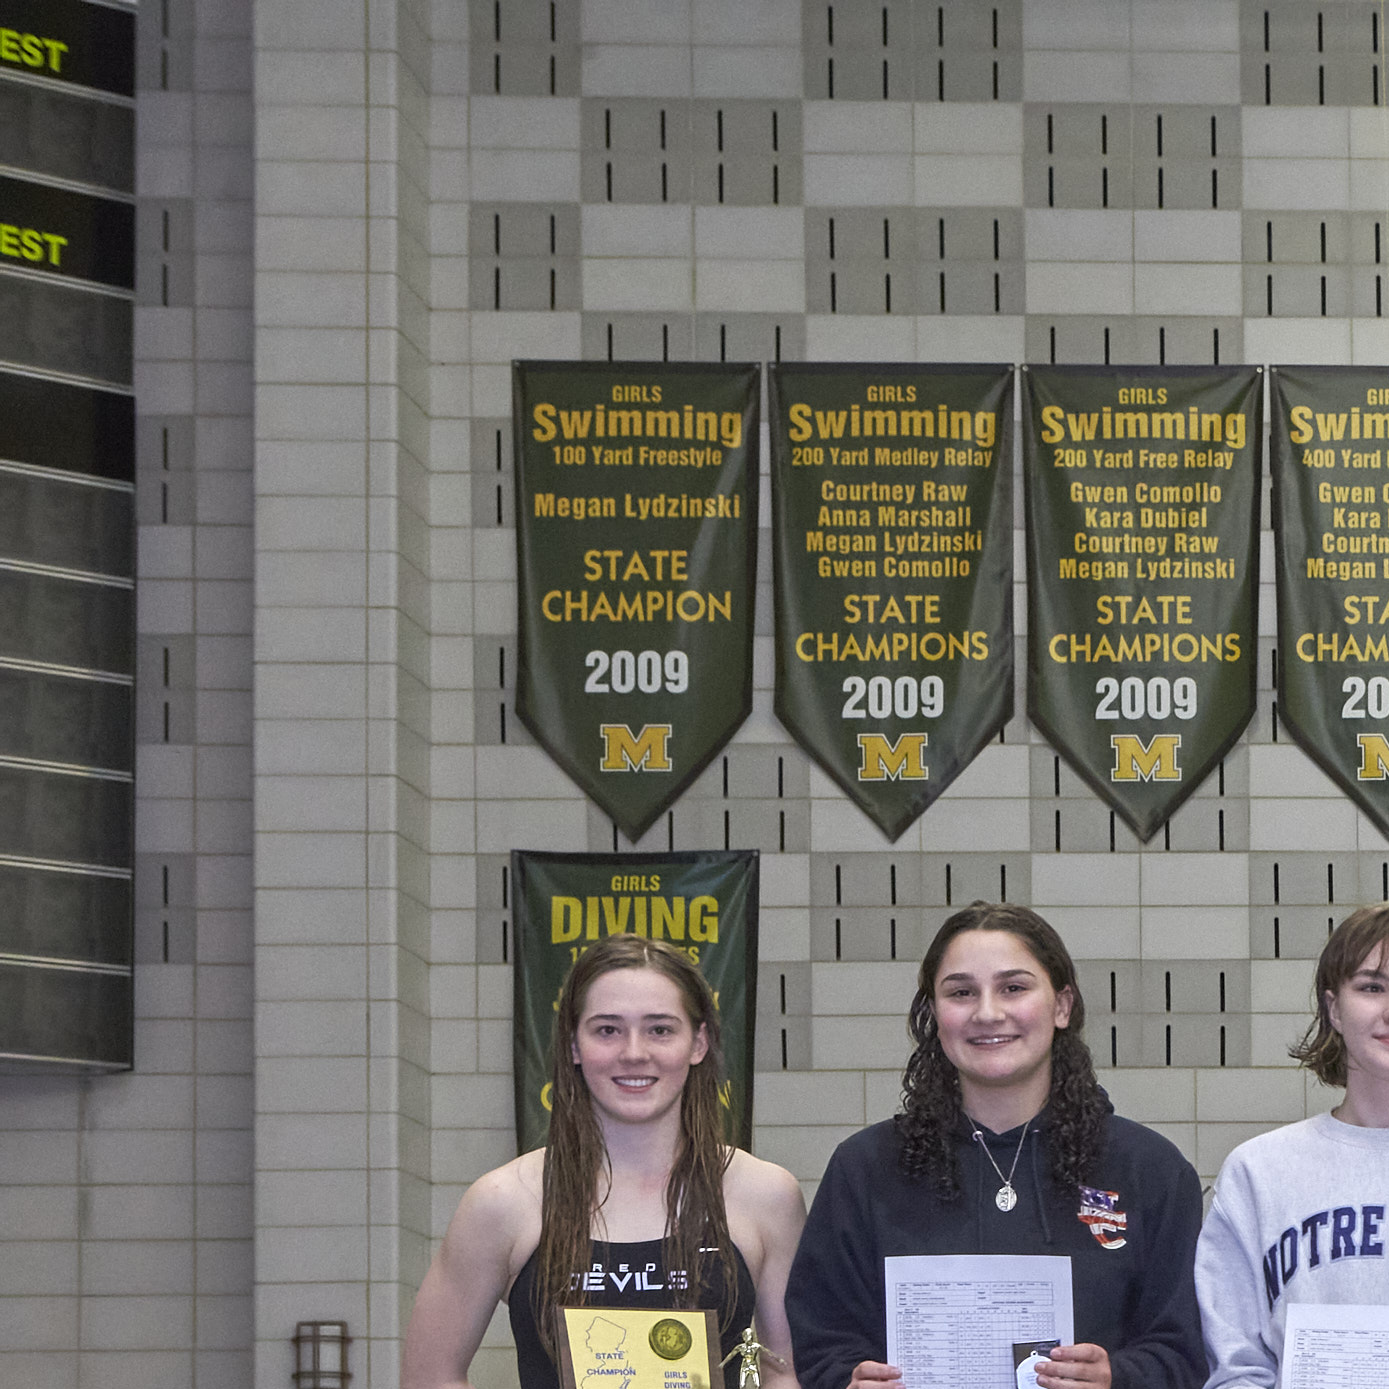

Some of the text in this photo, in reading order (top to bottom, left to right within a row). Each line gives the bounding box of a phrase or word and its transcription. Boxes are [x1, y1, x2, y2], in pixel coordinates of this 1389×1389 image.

[612, 386, 661, 403] GIRLS
[867, 386, 916, 402] GIRLS
[533, 404, 741, 450] Swimming
[790, 404, 995, 449] Swimming
[554, 445, 722, 467] 100 Yard Freestyle
[792, 446, 992, 468] 200 Yard Medley Relay
[822, 480, 967, 504] Courtney Raw
[535, 494, 740, 520] Megan Lydzinski
[818, 506, 970, 527] Anna Marshall
[806, 531, 982, 555] Megan Lydzinski
[584, 550, 687, 581] STATE
[819, 556, 970, 577] Gwen Comollo
[542, 590, 731, 622] CHAMPION
[844, 595, 940, 623] STATE
[1097, 595, 1192, 624] STATE
[796, 631, 988, 661] CHAMPIONS
[1049, 633, 1241, 662] CHAMPIONS
[585, 650, 688, 693] 2009
[842, 676, 943, 718] 2009
[1096, 677, 1197, 719] 2009
[600, 723, 672, 771] M
[611, 875, 660, 892] GIRLS
[551, 895, 719, 944] DIVING
[1262, 1204, 1385, 1313] NOTRE
[595, 1352, 624, 1360] STATE
[586, 1368, 636, 1376] CHAMPION
[664, 1371, 688, 1379] GIRLS
